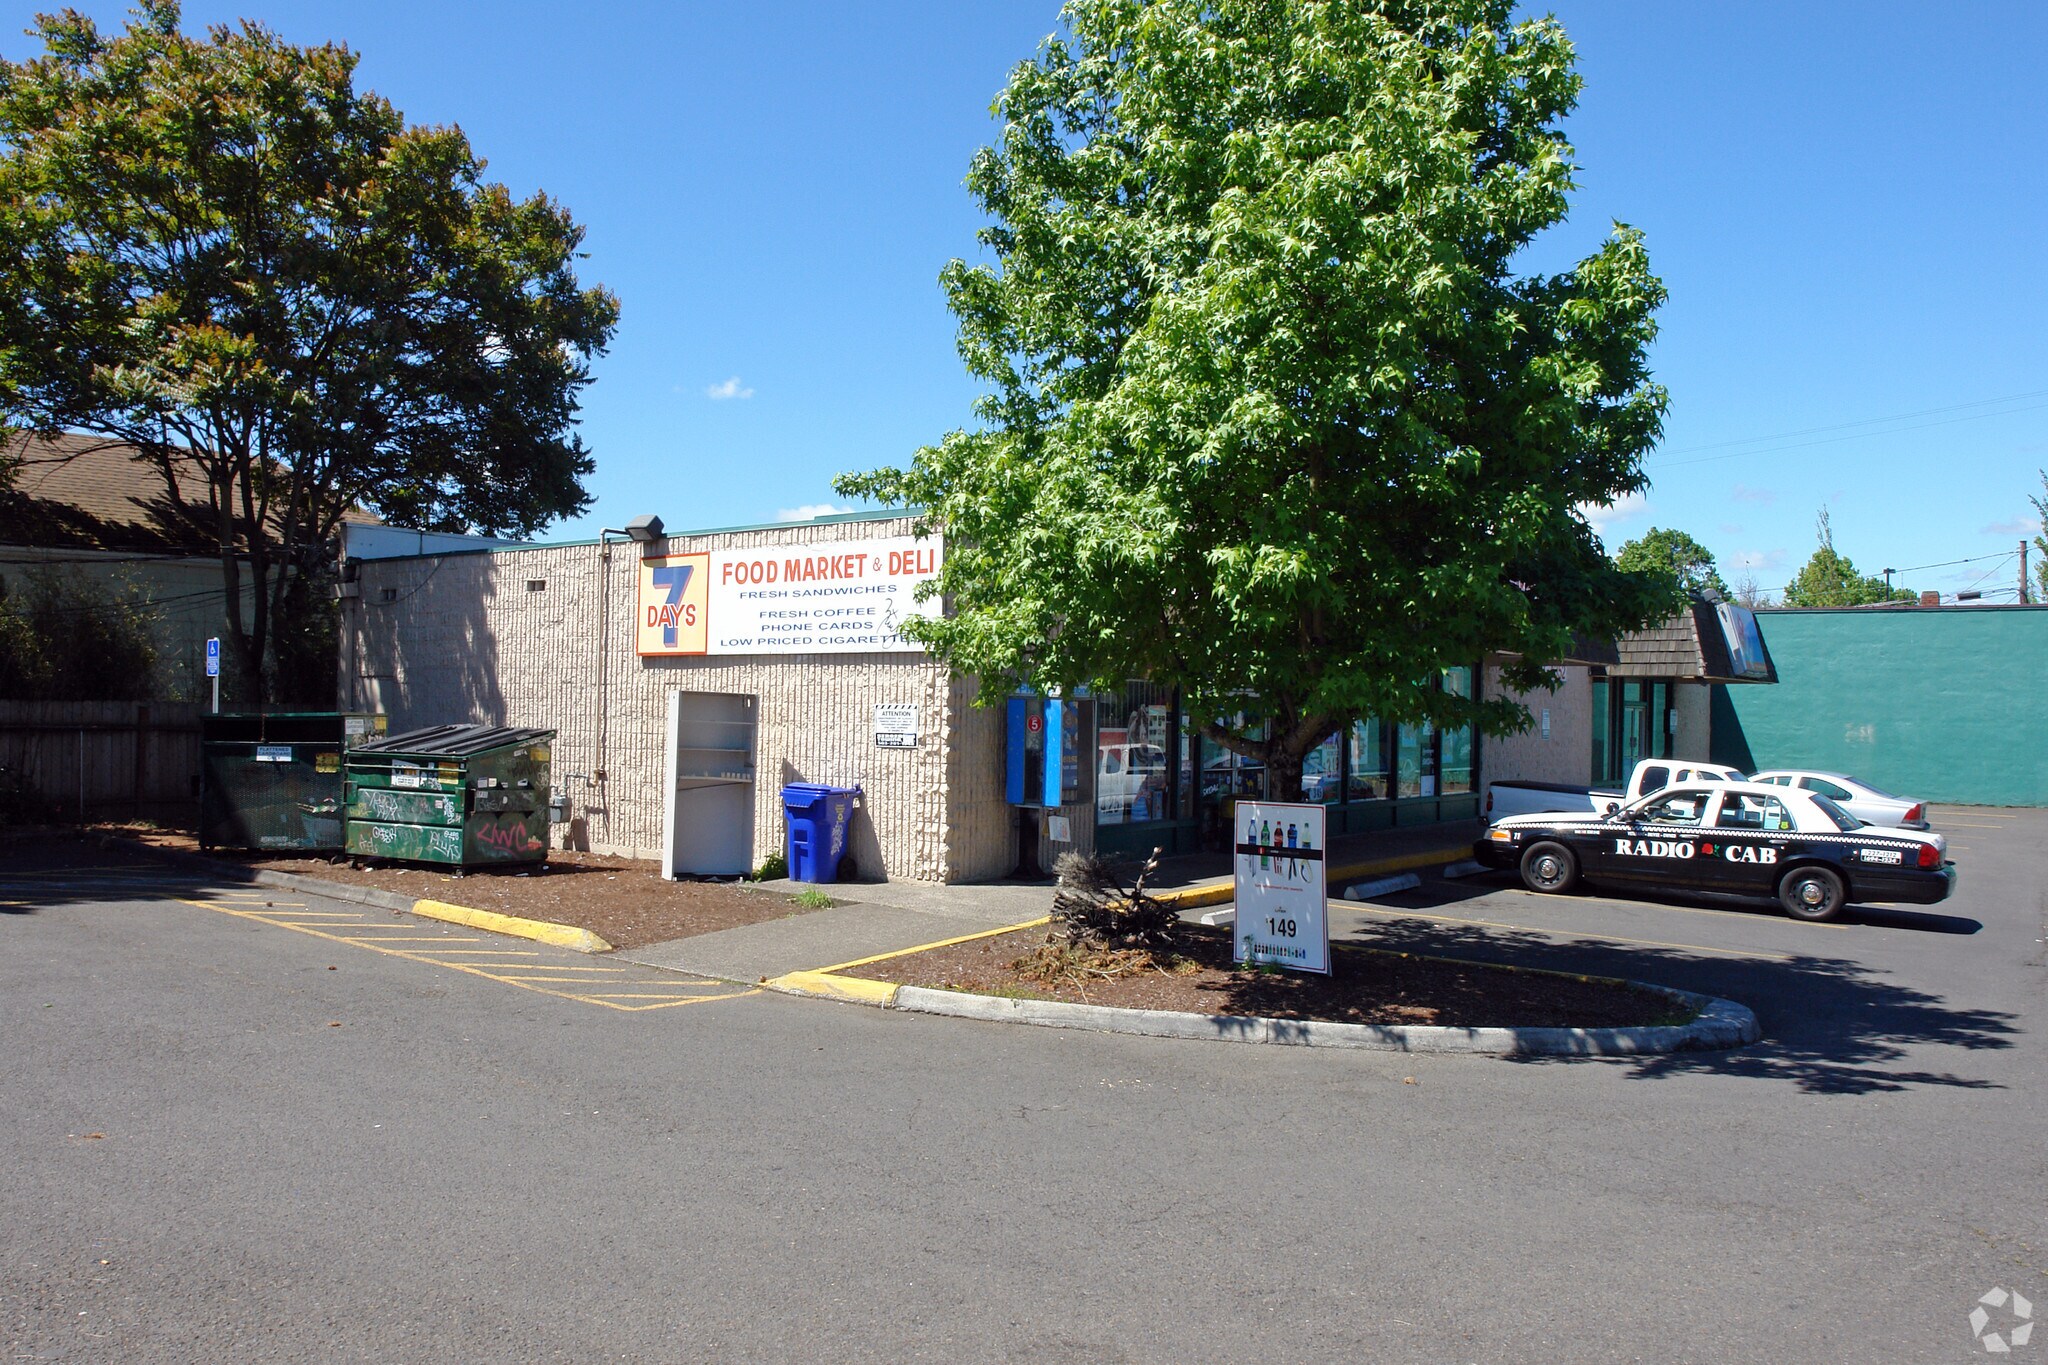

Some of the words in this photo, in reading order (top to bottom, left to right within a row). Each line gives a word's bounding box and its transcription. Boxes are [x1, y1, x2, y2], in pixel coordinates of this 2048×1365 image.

[722, 560, 778, 585] FOOD
[784, 553, 868, 582] MARKET
[872, 557, 882, 572] &
[888, 548, 935, 576] DELI
[740, 590, 788, 599] FRESH
[792, 584, 898, 597] SANDWICHES
[647, 603, 697, 629] DAYS
[652, 564, 695, 649] 7
[760, 609, 809, 619] FRESH
[813, 607, 876, 618] COFFEE
[761, 622, 813, 632] PHONE
[818, 621, 873, 631] CARDS
[720, 637, 752, 647] LOW
[757, 636, 812, 646] PRICED
[1615, 838, 1695, 859] RADIO
[1725, 845, 1777, 864] CAB
